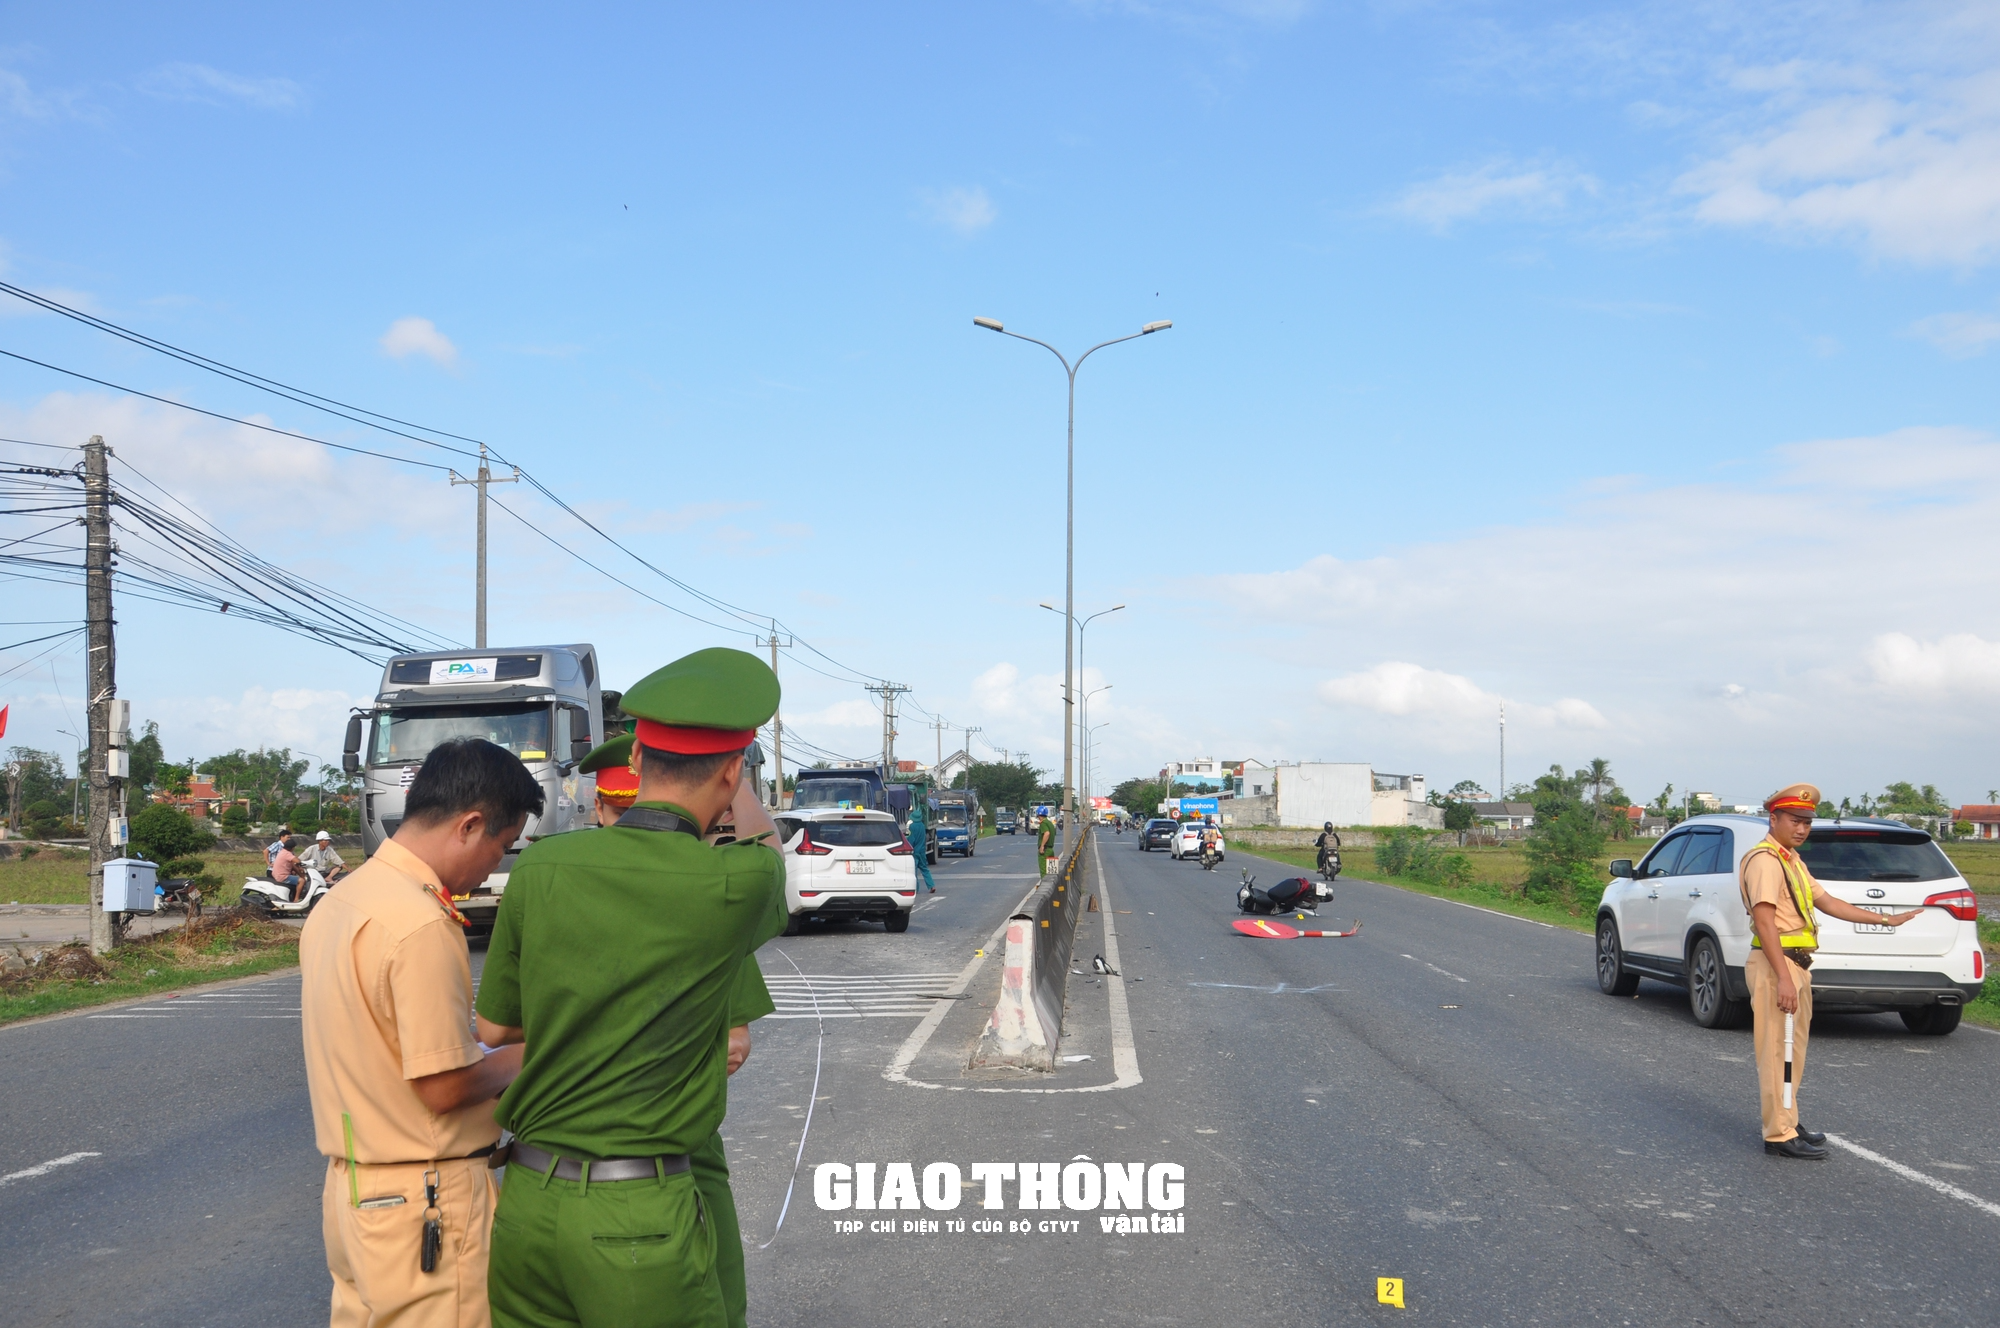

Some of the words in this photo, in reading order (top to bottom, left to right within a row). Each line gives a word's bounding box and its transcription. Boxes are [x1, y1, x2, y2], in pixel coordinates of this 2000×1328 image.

[449, 663, 475, 673] PA
[1183, 802, 1215, 810] vinaphone
[1386, 1282, 1394, 1296] 2
